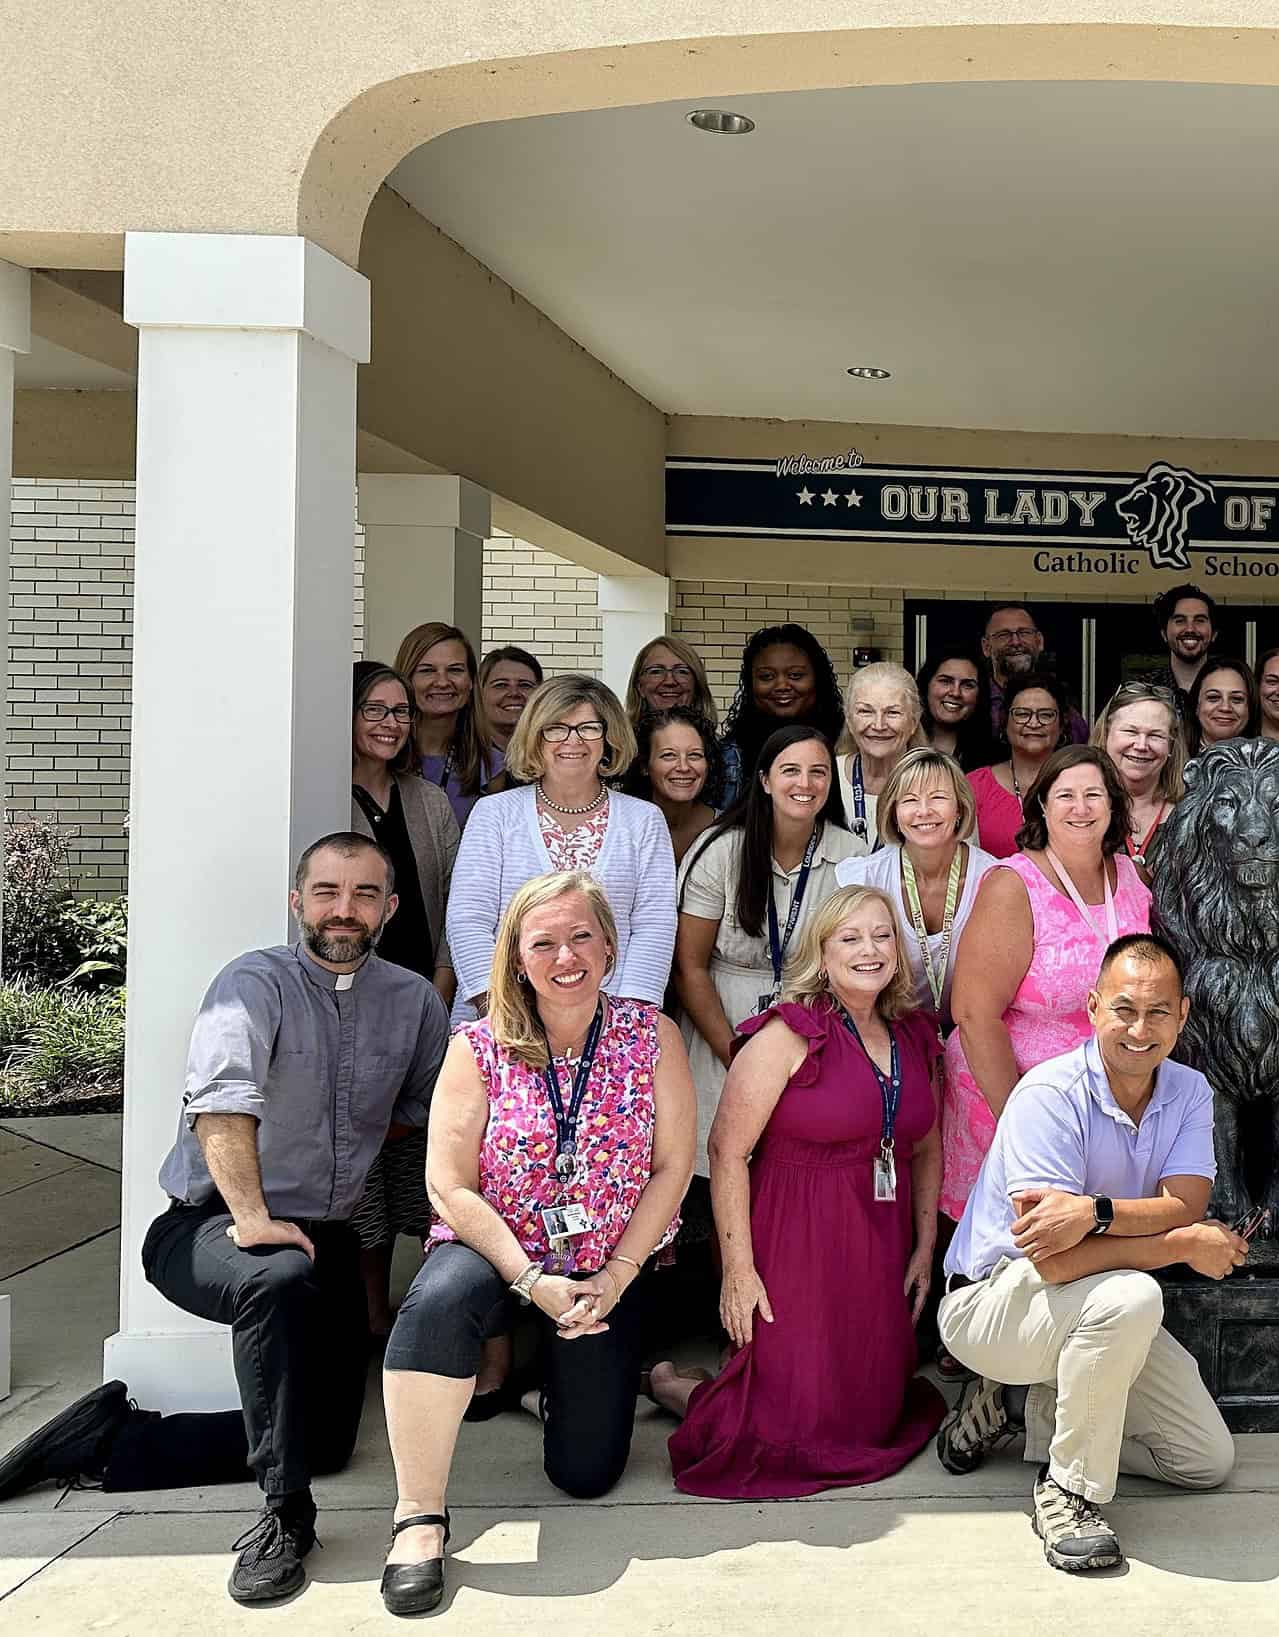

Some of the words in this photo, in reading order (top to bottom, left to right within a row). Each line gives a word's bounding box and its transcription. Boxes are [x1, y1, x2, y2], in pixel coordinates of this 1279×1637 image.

[776, 453, 845, 478] Welcome
[848, 448, 864, 468] to
[880, 484, 970, 522] OUR
[984, 488, 1106, 526] LADY
[1224, 496, 1276, 531] OF
[1033, 551, 1140, 574] Catholic
